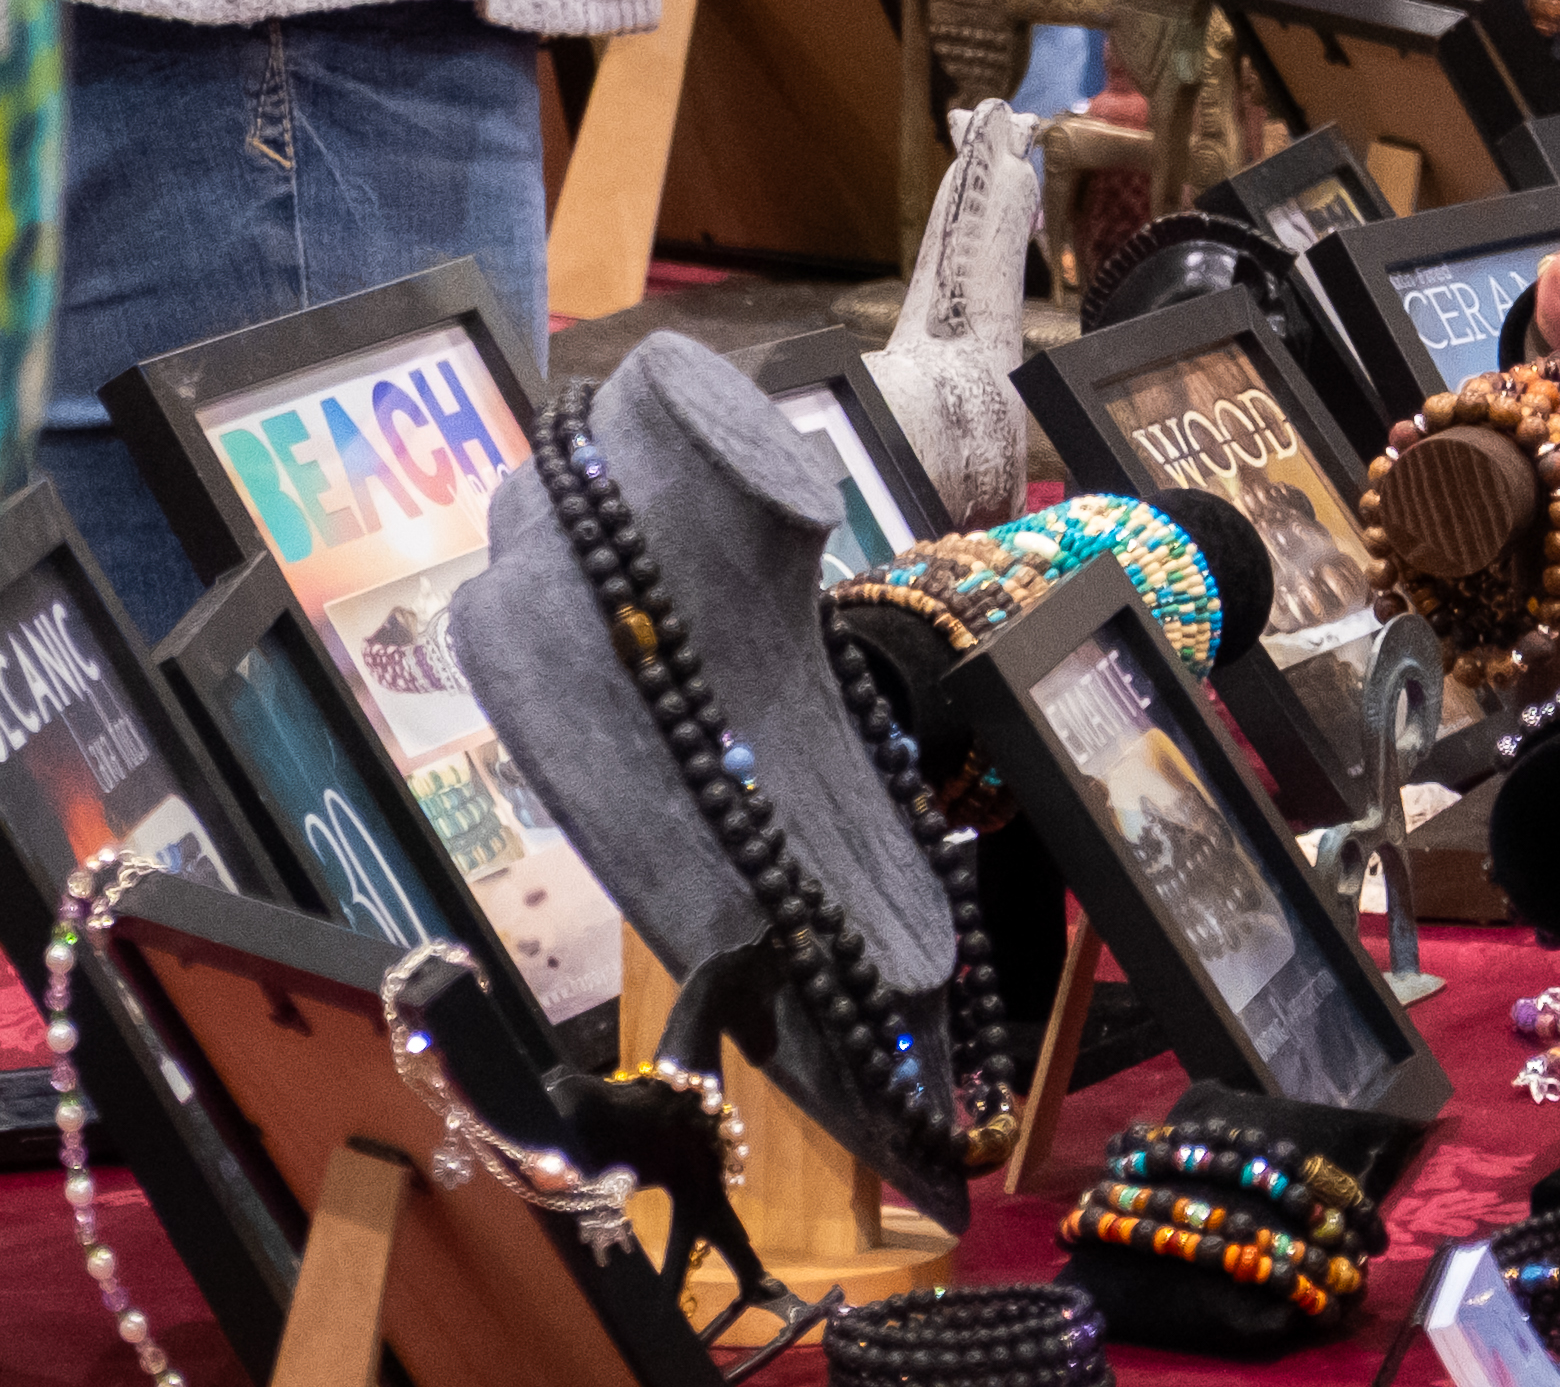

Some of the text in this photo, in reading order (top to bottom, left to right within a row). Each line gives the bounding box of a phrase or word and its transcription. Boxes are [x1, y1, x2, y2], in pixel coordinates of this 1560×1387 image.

[219, 359, 508, 564] BEACH
[1132, 388, 1298, 490] WOOD
[1045, 649, 1151, 765] EMATITE
